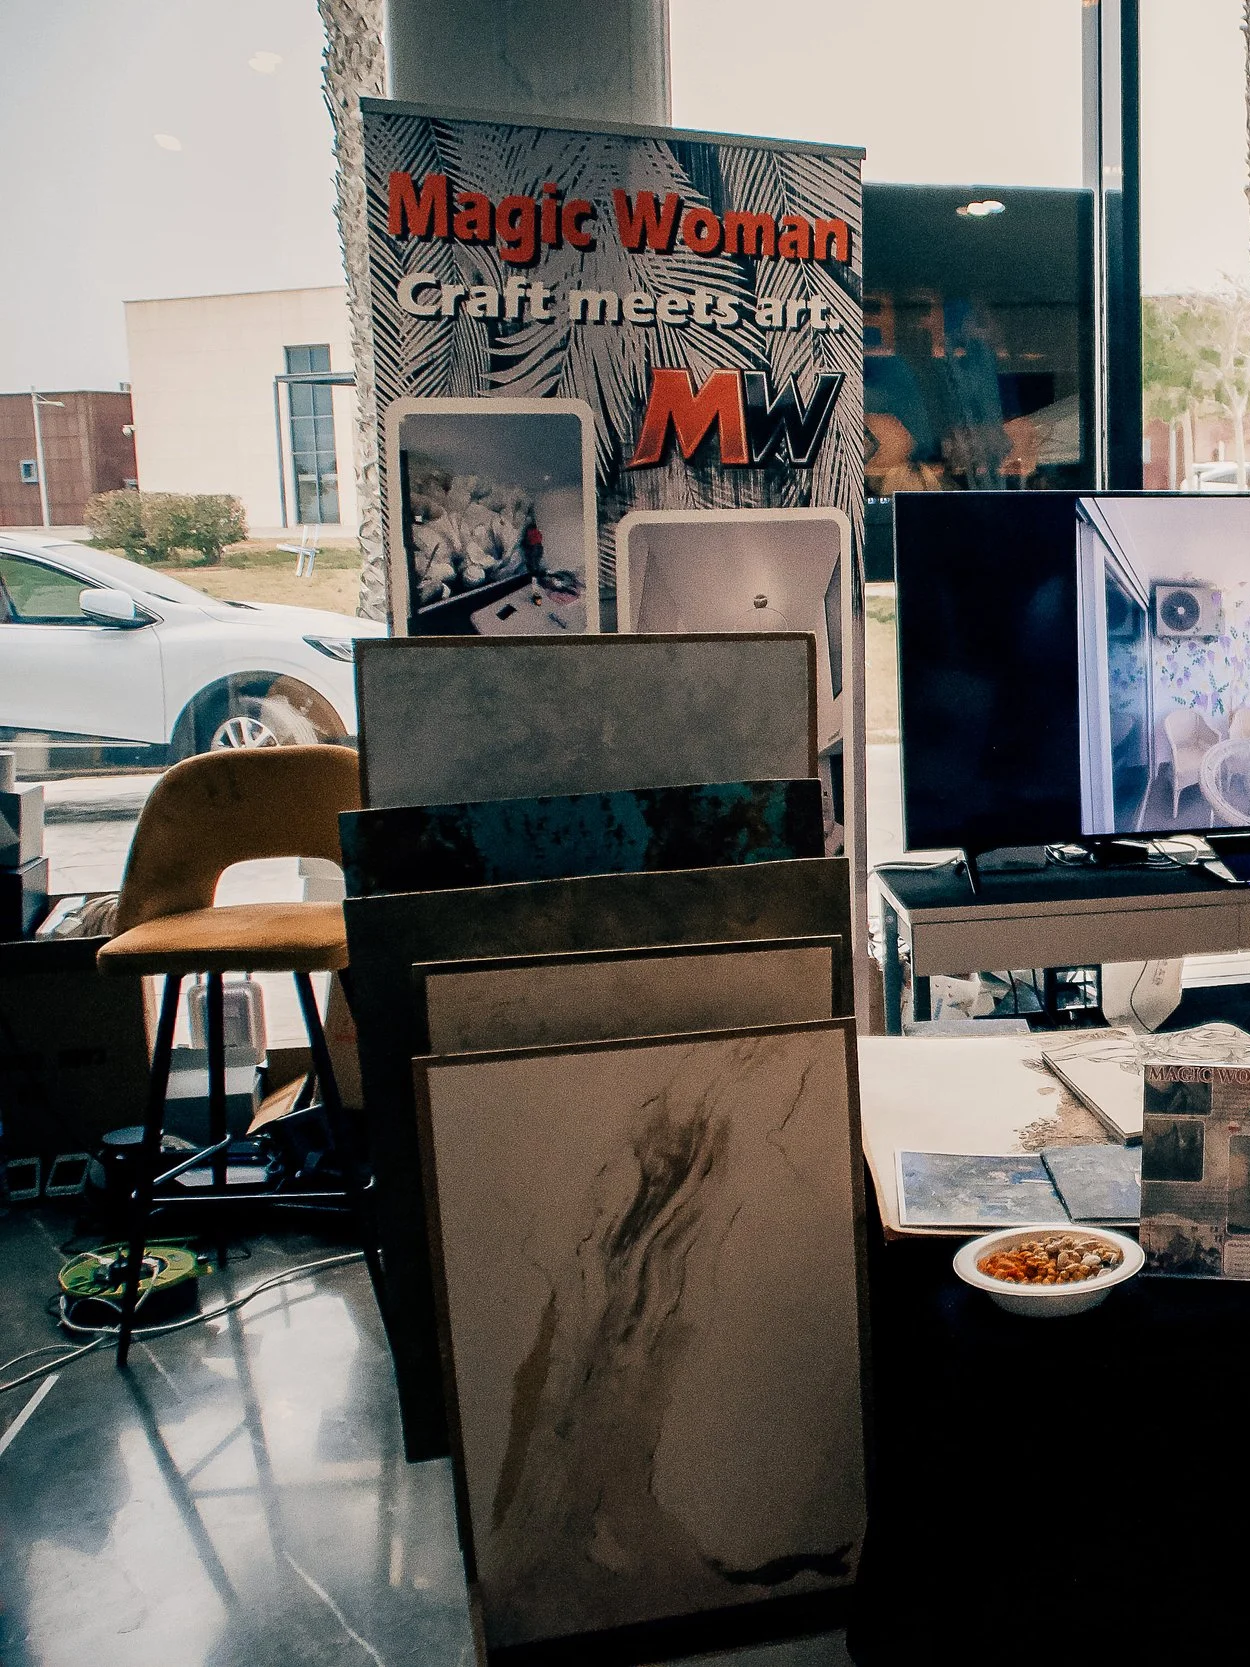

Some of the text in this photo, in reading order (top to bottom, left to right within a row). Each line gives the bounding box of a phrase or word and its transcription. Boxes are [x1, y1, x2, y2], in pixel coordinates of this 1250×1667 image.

[388, 172, 849, 264] Magic Woman
[397, 272, 841, 329] Craft meets art.
[626, 367, 844, 469] MW
[1149, 1065, 1213, 1083] MAGIC
